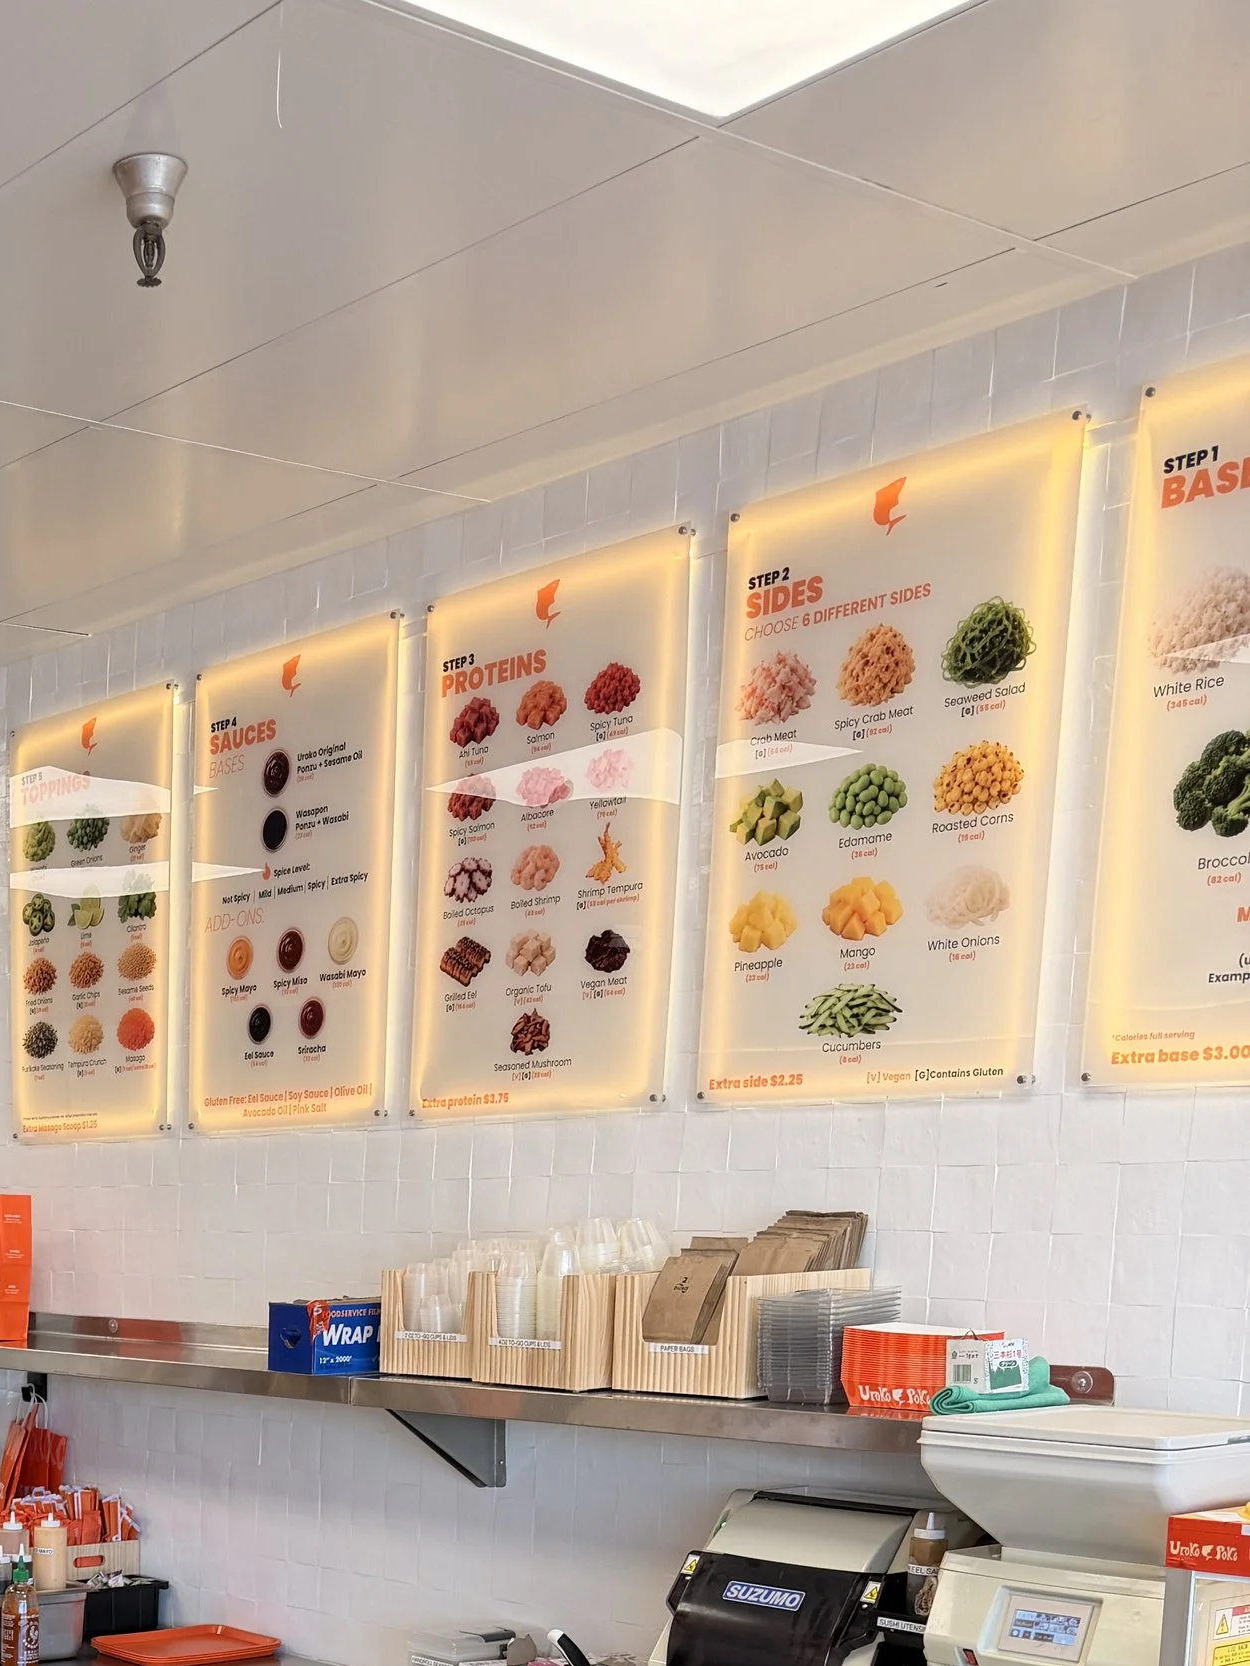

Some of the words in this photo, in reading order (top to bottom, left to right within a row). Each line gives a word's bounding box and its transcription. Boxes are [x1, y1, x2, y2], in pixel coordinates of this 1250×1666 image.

[1163, 448, 1208, 474] STEP
[1211, 445, 1219, 461] 1
[748, 570, 780, 590] STEP
[782, 566, 790, 581] 2
[746, 576, 823, 619] SIDES
[744, 616, 799, 642] CHOOSE
[802, 612, 810, 627] 6
[814, 594, 887, 624] DIFFERENT
[890, 583, 931, 605] SIDES
[443, 656, 467, 672] STEP
[469, 654, 475, 665] 3
[441, 649, 547, 698] PROTEINS
[1153, 681, 1193, 698] White
[1195, 675, 1225, 690] Rice
[944, 688, 992, 708] Seaweed
[995, 683, 1025, 697] Salad
[210, 718, 230, 734] STEP
[231, 717, 237, 727] 4
[590, 719, 612, 731] Spicy
[614, 714, 633, 725] Tuna
[834, 717, 860, 731] Spicy
[862, 710, 887, 725] Crab
[889, 706, 913, 719] Meat
[210, 719, 276, 755] SAUCES
[527, 732, 555, 744] Salmon
[750, 732, 771, 747] Crab
[774, 729, 797, 742] Meat
[318, 742, 346, 757] Original
[471, 745, 489, 757] Tuna
[209, 755, 245, 779] BASES
[21, 771, 90, 805] TOPPINGS
[589, 796, 626, 810] Yellowtail
[521, 808, 554, 822] Albacore
[932, 816, 977, 834] Roasted
[979, 812, 1014, 828] Corns
[449, 826, 467, 839] Spicy
[469, 822, 495, 836] Salmon
[838, 831, 892, 849] Edamame
[745, 845, 789, 862] Avocado
[307, 879, 326, 892] Spicy
[331, 875, 349, 887] Extra
[350, 871, 369, 886] Spicy
[258, 889, 272, 900] Mild
[277, 884, 304, 897] Medium
[578, 887, 605, 900] Shrimp
[607, 881, 643, 895] Tempura
[234, 893, 250, 905] Spicy
[534, 894, 561, 907] Shrimp
[464, 904, 494, 918] Octopus
[927, 937, 957, 951] White
[961, 934, 1000, 949] Onions
[840, 946, 875, 959] Mango
[734, 957, 783, 973] Pineapple
[273, 978, 292, 990] Spicy
[292, 975, 308, 988] Miso
[319, 970, 345, 983] Wasabi
[346, 967, 366, 980] Mayo
[580, 978, 606, 990] Vegan
[608, 976, 627, 988] Meat
[221, 985, 238, 998] Spicy
[239, 983, 257, 996] Mayo
[444, 991, 465, 1003] Grilled
[467, 990, 477, 1001] Eel
[505, 984, 534, 998] Organic
[535, 983, 552, 994] Tofu
[297, 1044, 326, 1055] Sriracha
[822, 1040, 881, 1053] Cucumbers
[244, 1051, 255, 1061] Eel
[255, 1050, 274, 1060] Sauce
[1111, 1051, 1155, 1065] Extra
[1158, 1049, 1200, 1063] base
[494, 1060, 530, 1073] Seasoned
[532, 1057, 572, 1069] Mushroom
[709, 1077, 740, 1090] Extra
[743, 1075, 767, 1089] side
[770, 1073, 803, 1087] $2.25
[204, 1096, 228, 1108] Gluten
[259, 1091, 284, 1103] Sauce
[288, 1090, 302, 1102] Soy
[303, 1089, 329, 1101] Sauce
[334, 1086, 356, 1098] Olive
[357, 1085, 368, 1096] Oil
[421, 1096, 447, 1109] Extra
[448, 1094, 482, 1110] protein
[484, 1092, 509, 1106] $3.75
[242, 1107, 276, 1118] Avocado
[293, 1104, 309, 1115] Pink
[311, 1103, 327, 1114] Salt
[322, 1324, 373, 1346] WRAP
[661, 1344, 677, 1352] PAPER
[679, 1345, 695, 1353] BAGS
[726, 1584, 800, 1608] SUZUMO
